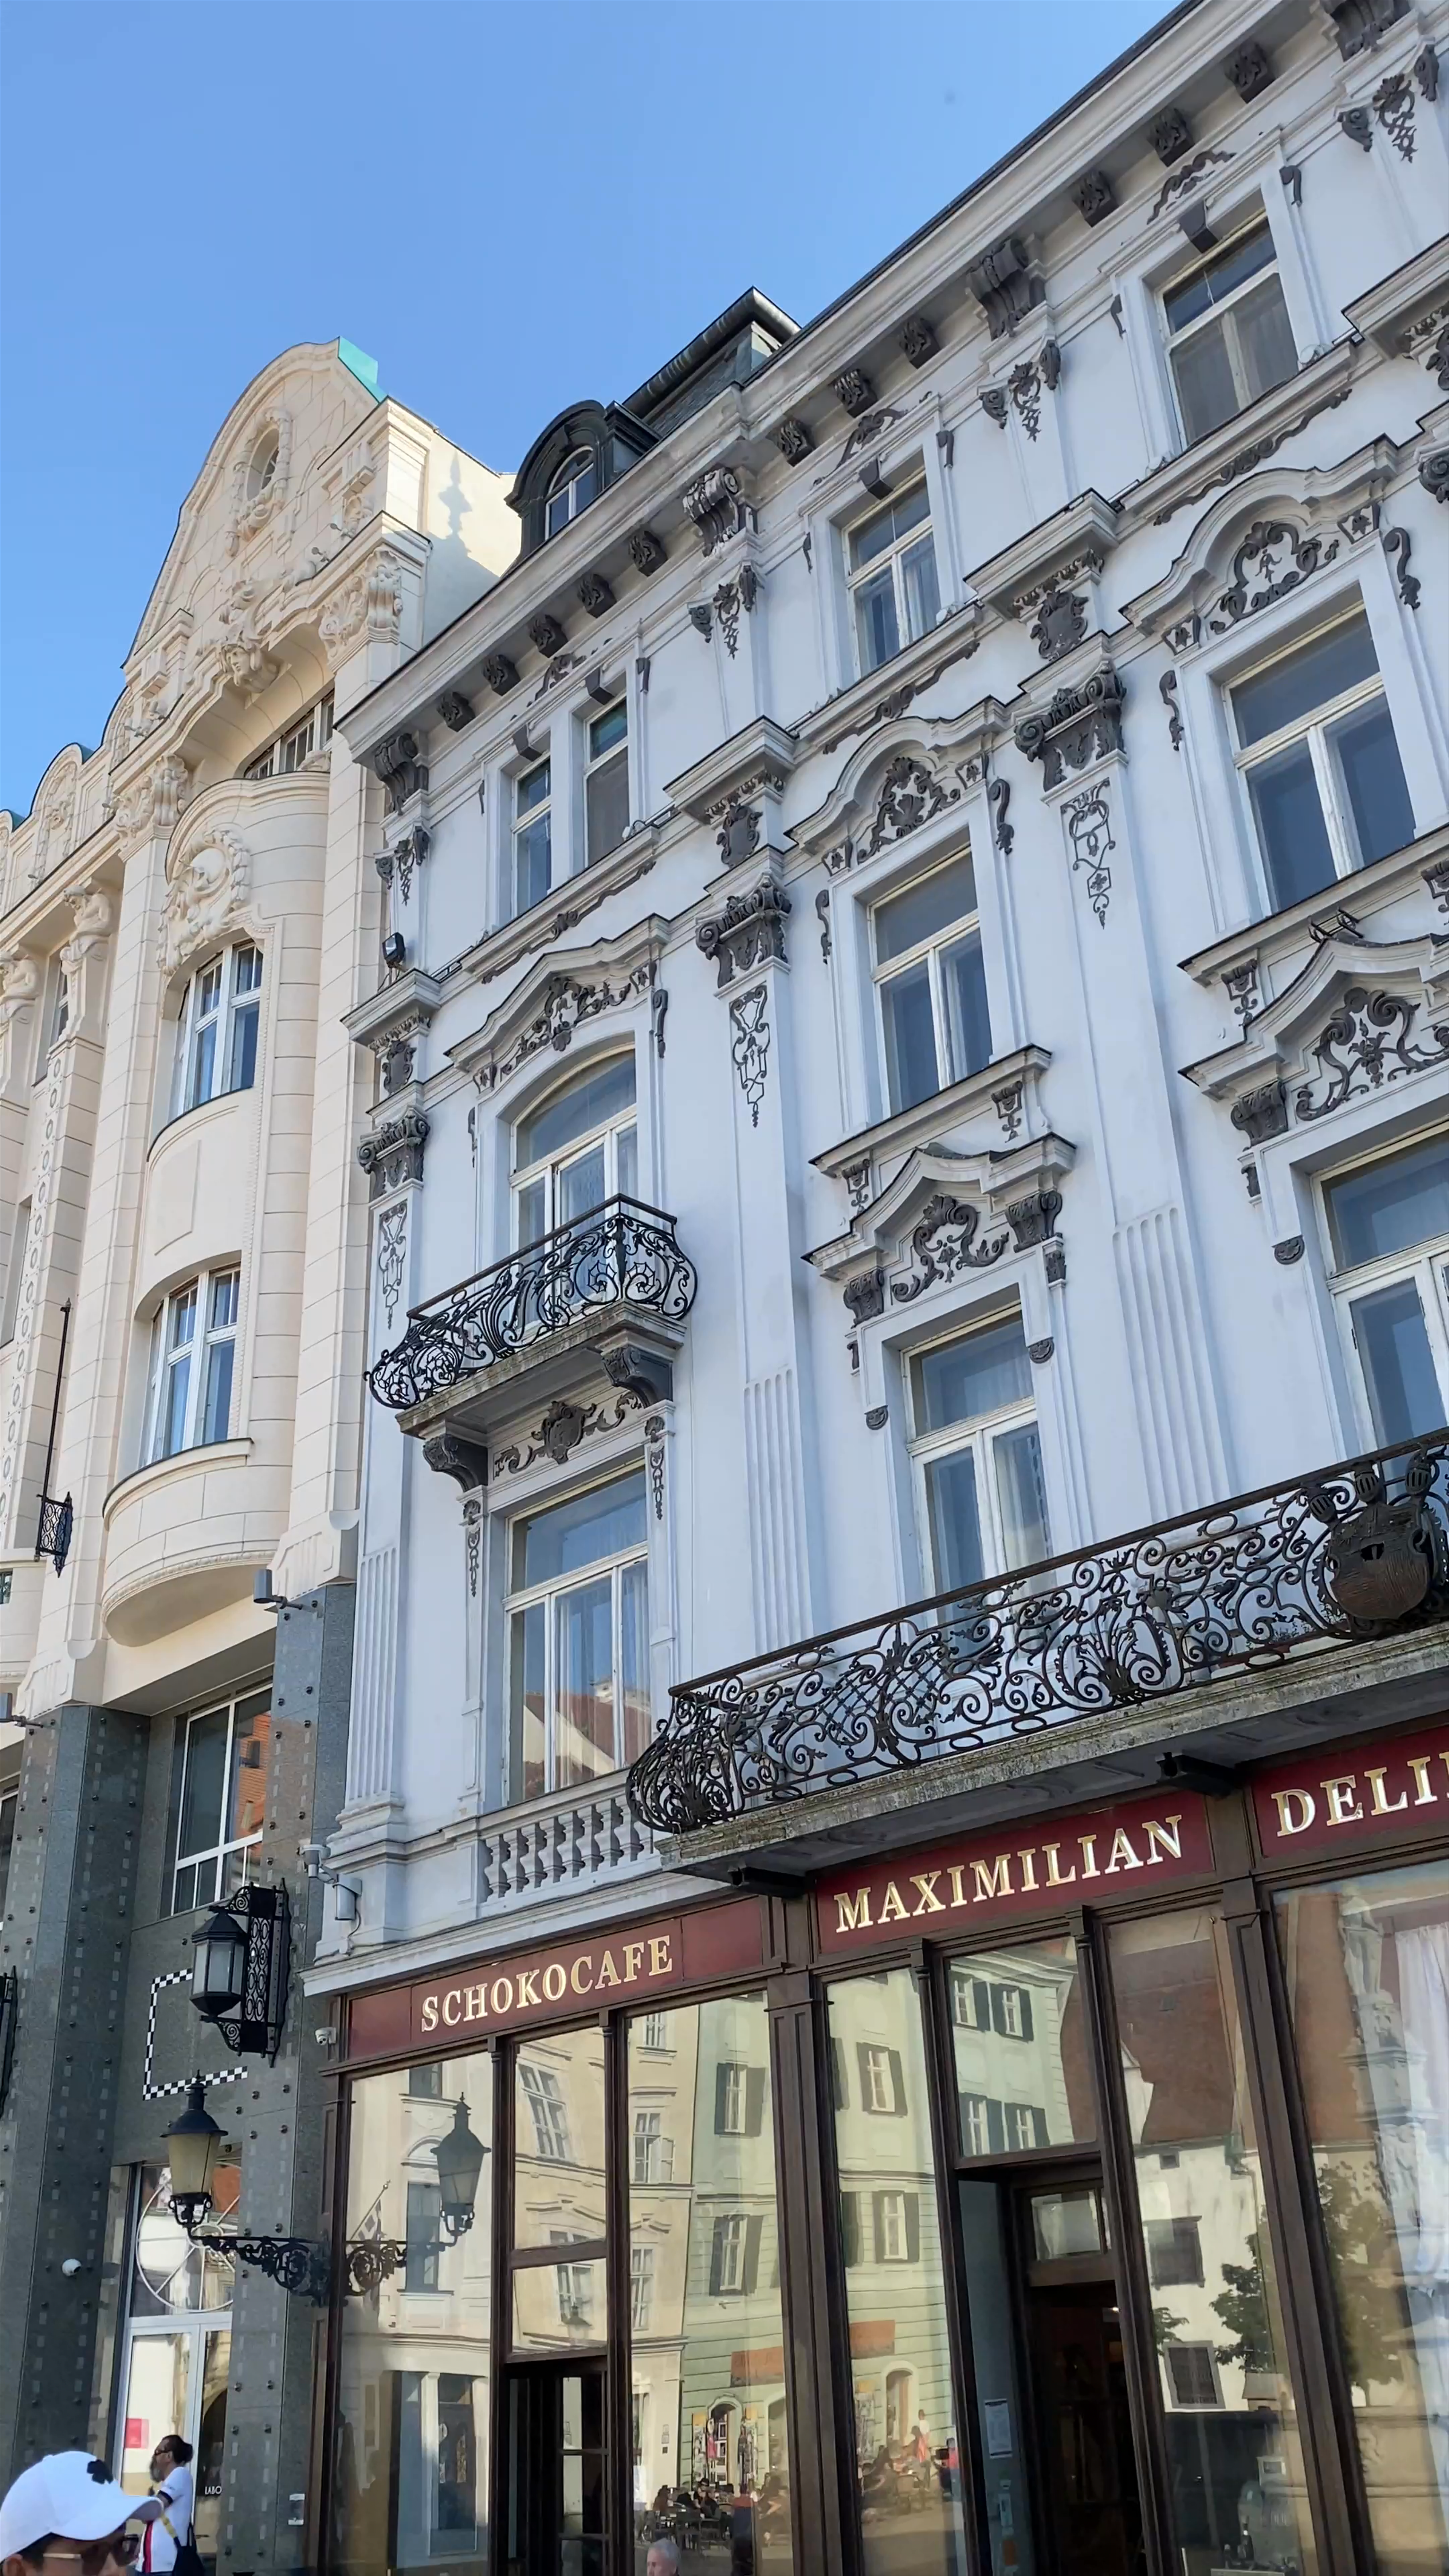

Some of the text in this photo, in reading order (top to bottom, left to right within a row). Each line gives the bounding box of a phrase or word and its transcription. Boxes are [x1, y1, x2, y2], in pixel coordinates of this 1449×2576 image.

[1271, 1752, 1449, 1837] DELI
[834, 1815, 1182, 1933] MAXIMILIAN
[421, 1935, 672, 2032] SCHOKOCAFE
